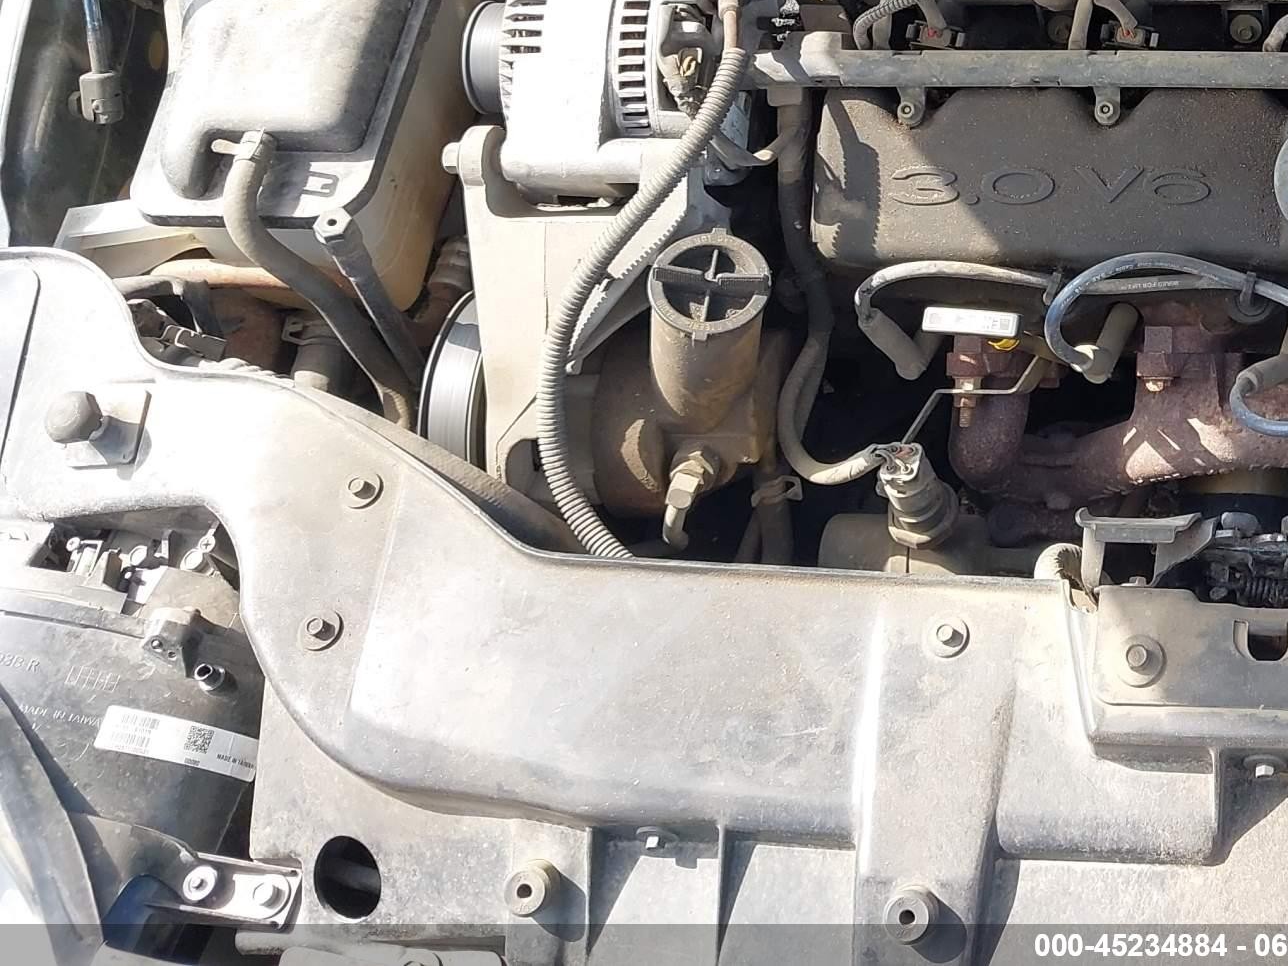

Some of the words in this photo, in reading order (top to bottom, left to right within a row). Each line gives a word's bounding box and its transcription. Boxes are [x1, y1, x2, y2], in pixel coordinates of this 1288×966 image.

[890, 165, 1056, 206] 3.0
[1074, 164, 1212, 206] V6
[69, 713, 101, 727] TAIWA
